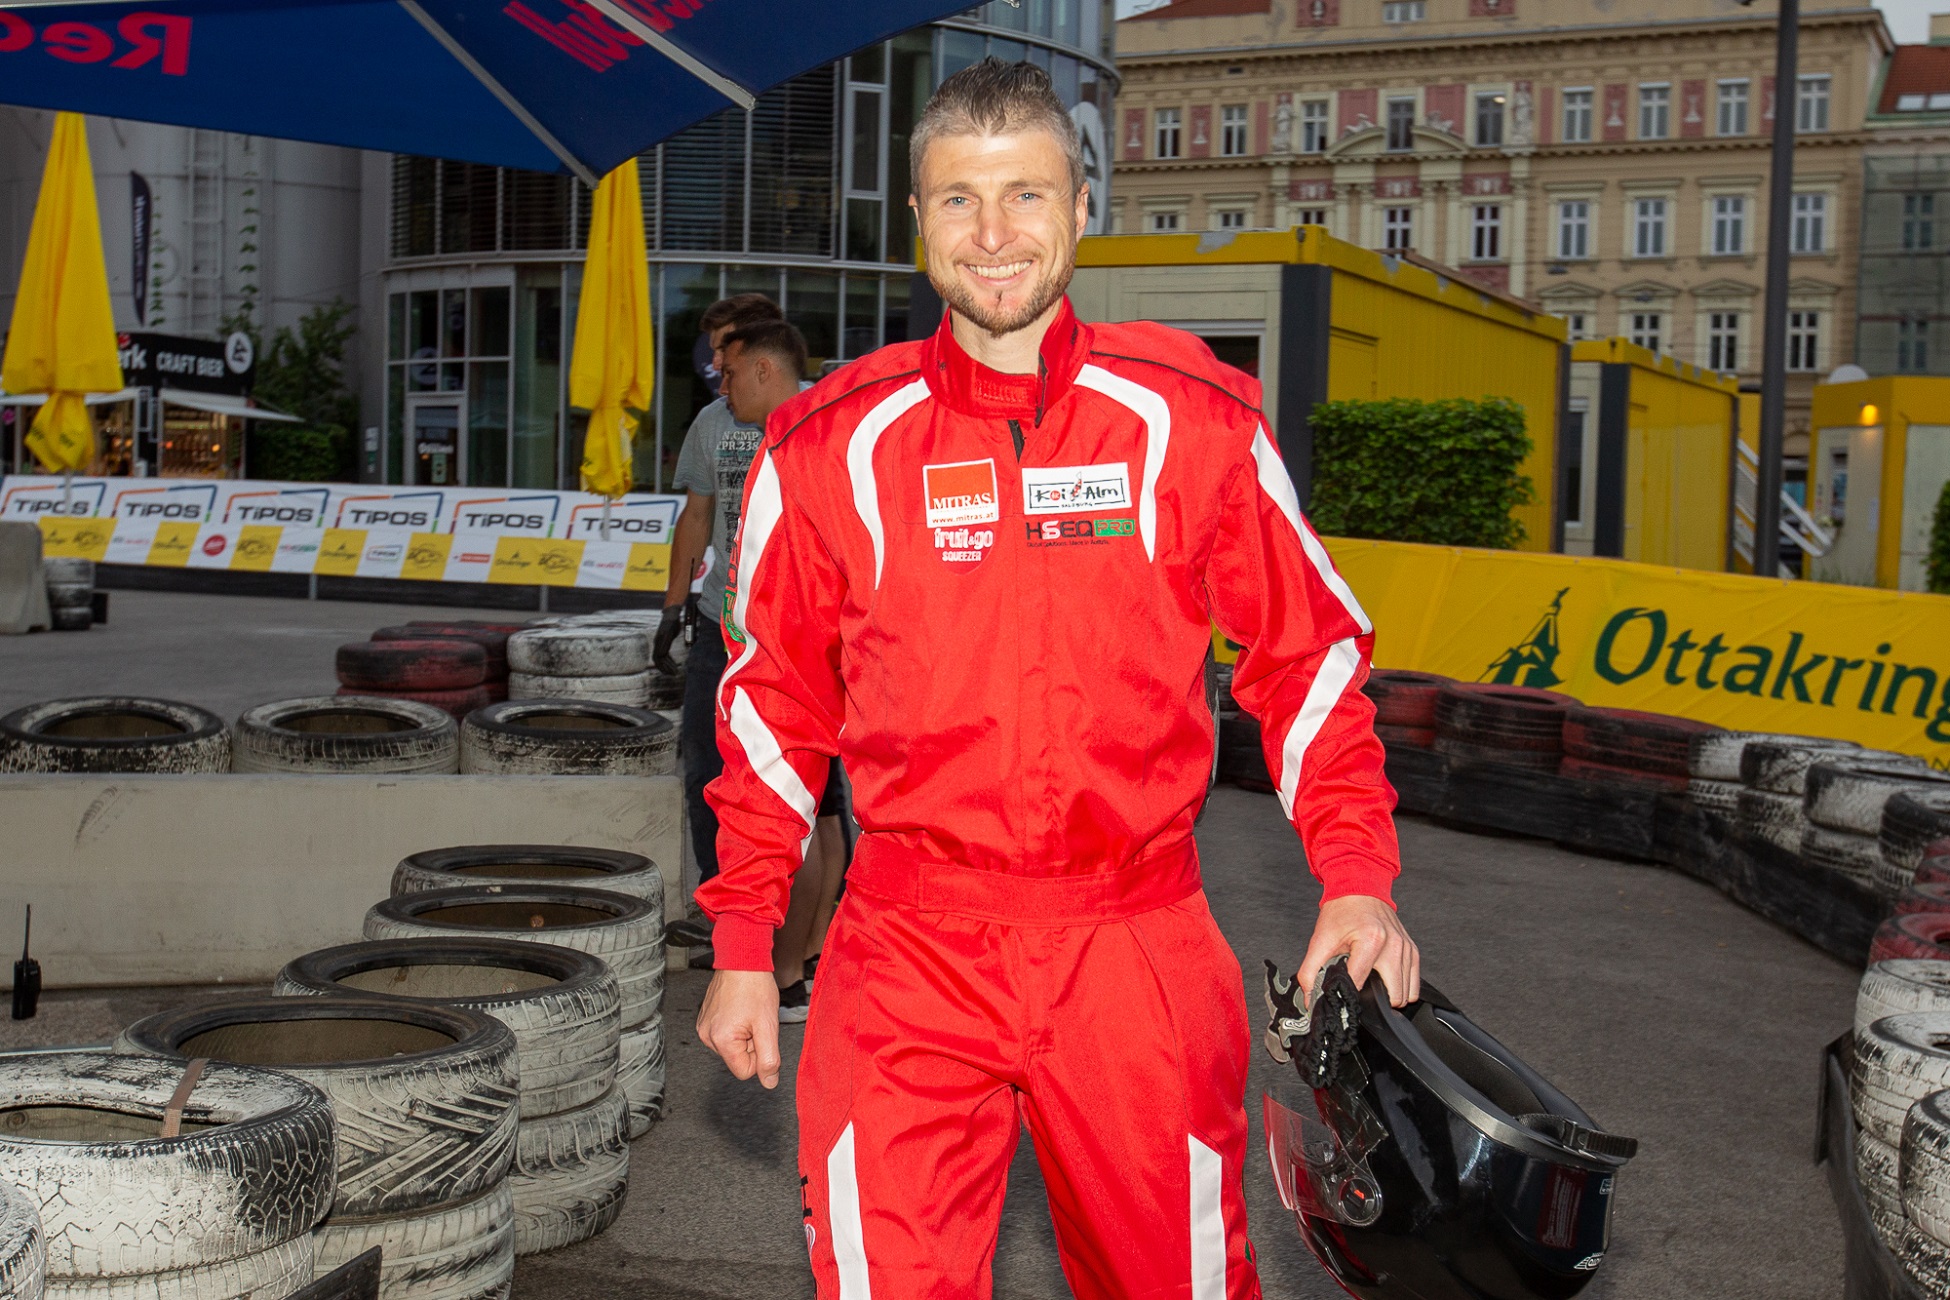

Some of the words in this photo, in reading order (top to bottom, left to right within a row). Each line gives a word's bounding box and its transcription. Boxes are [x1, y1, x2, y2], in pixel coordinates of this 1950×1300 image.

[157, 352, 196, 374] CRAFT
[197, 357, 224, 378] BEER
[1082, 486, 1119, 500] Alm
[932, 492, 992, 510] MITRAS
[932, 512, 994, 524] www.mitras.at
[942, 550, 982, 562] SQUEEZER
